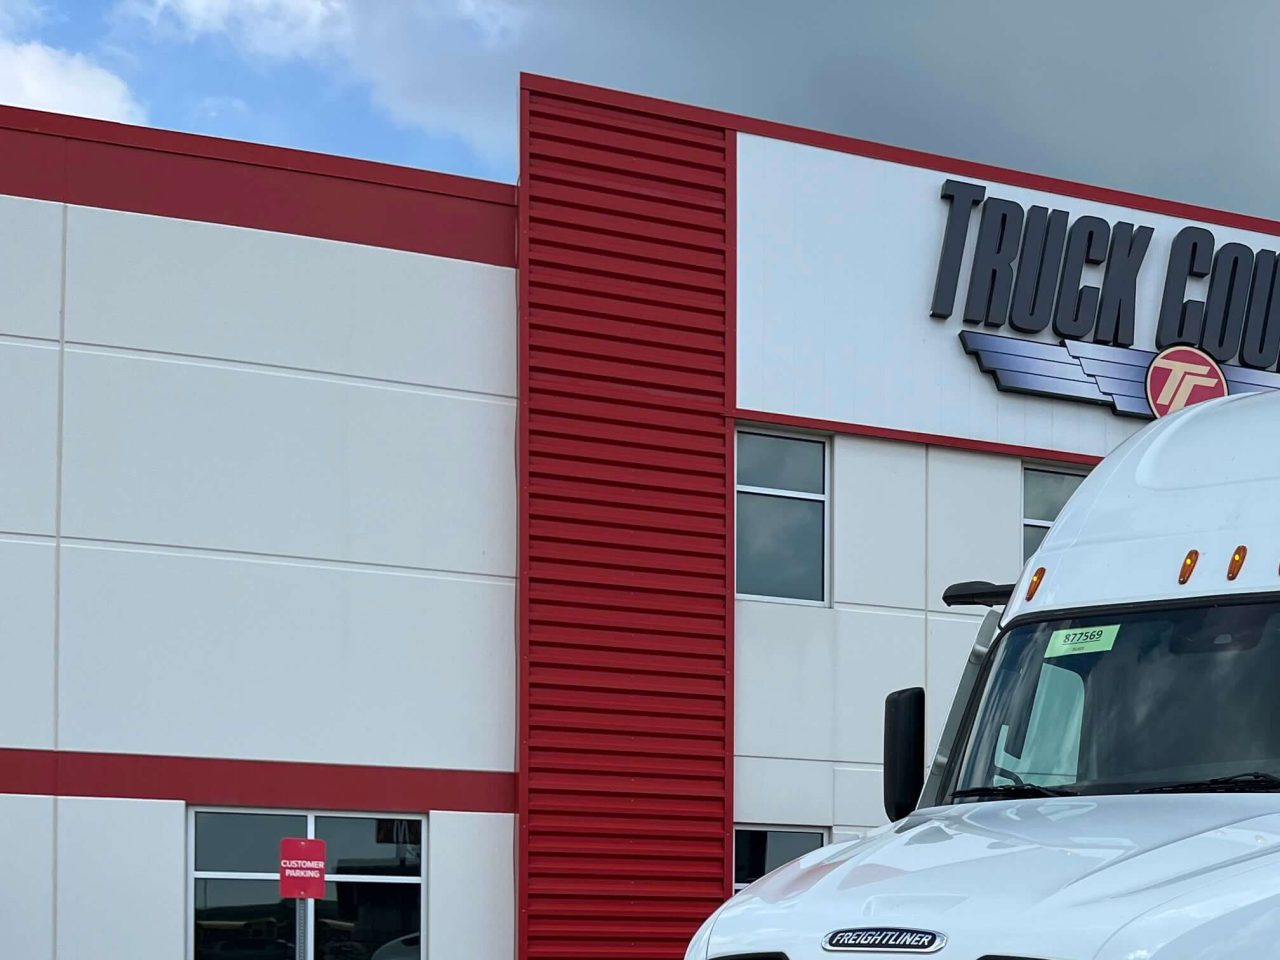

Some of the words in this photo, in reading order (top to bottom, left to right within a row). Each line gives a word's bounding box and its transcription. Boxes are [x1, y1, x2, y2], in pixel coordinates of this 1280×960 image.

[930, 179, 1155, 347] TRUCK
[1063, 630, 1103, 643] 877569
[281, 860, 325, 868] CUSTOMER
[286, 869, 320, 878] PARKING
[832, 931, 932, 946] FREIGHTLINER
